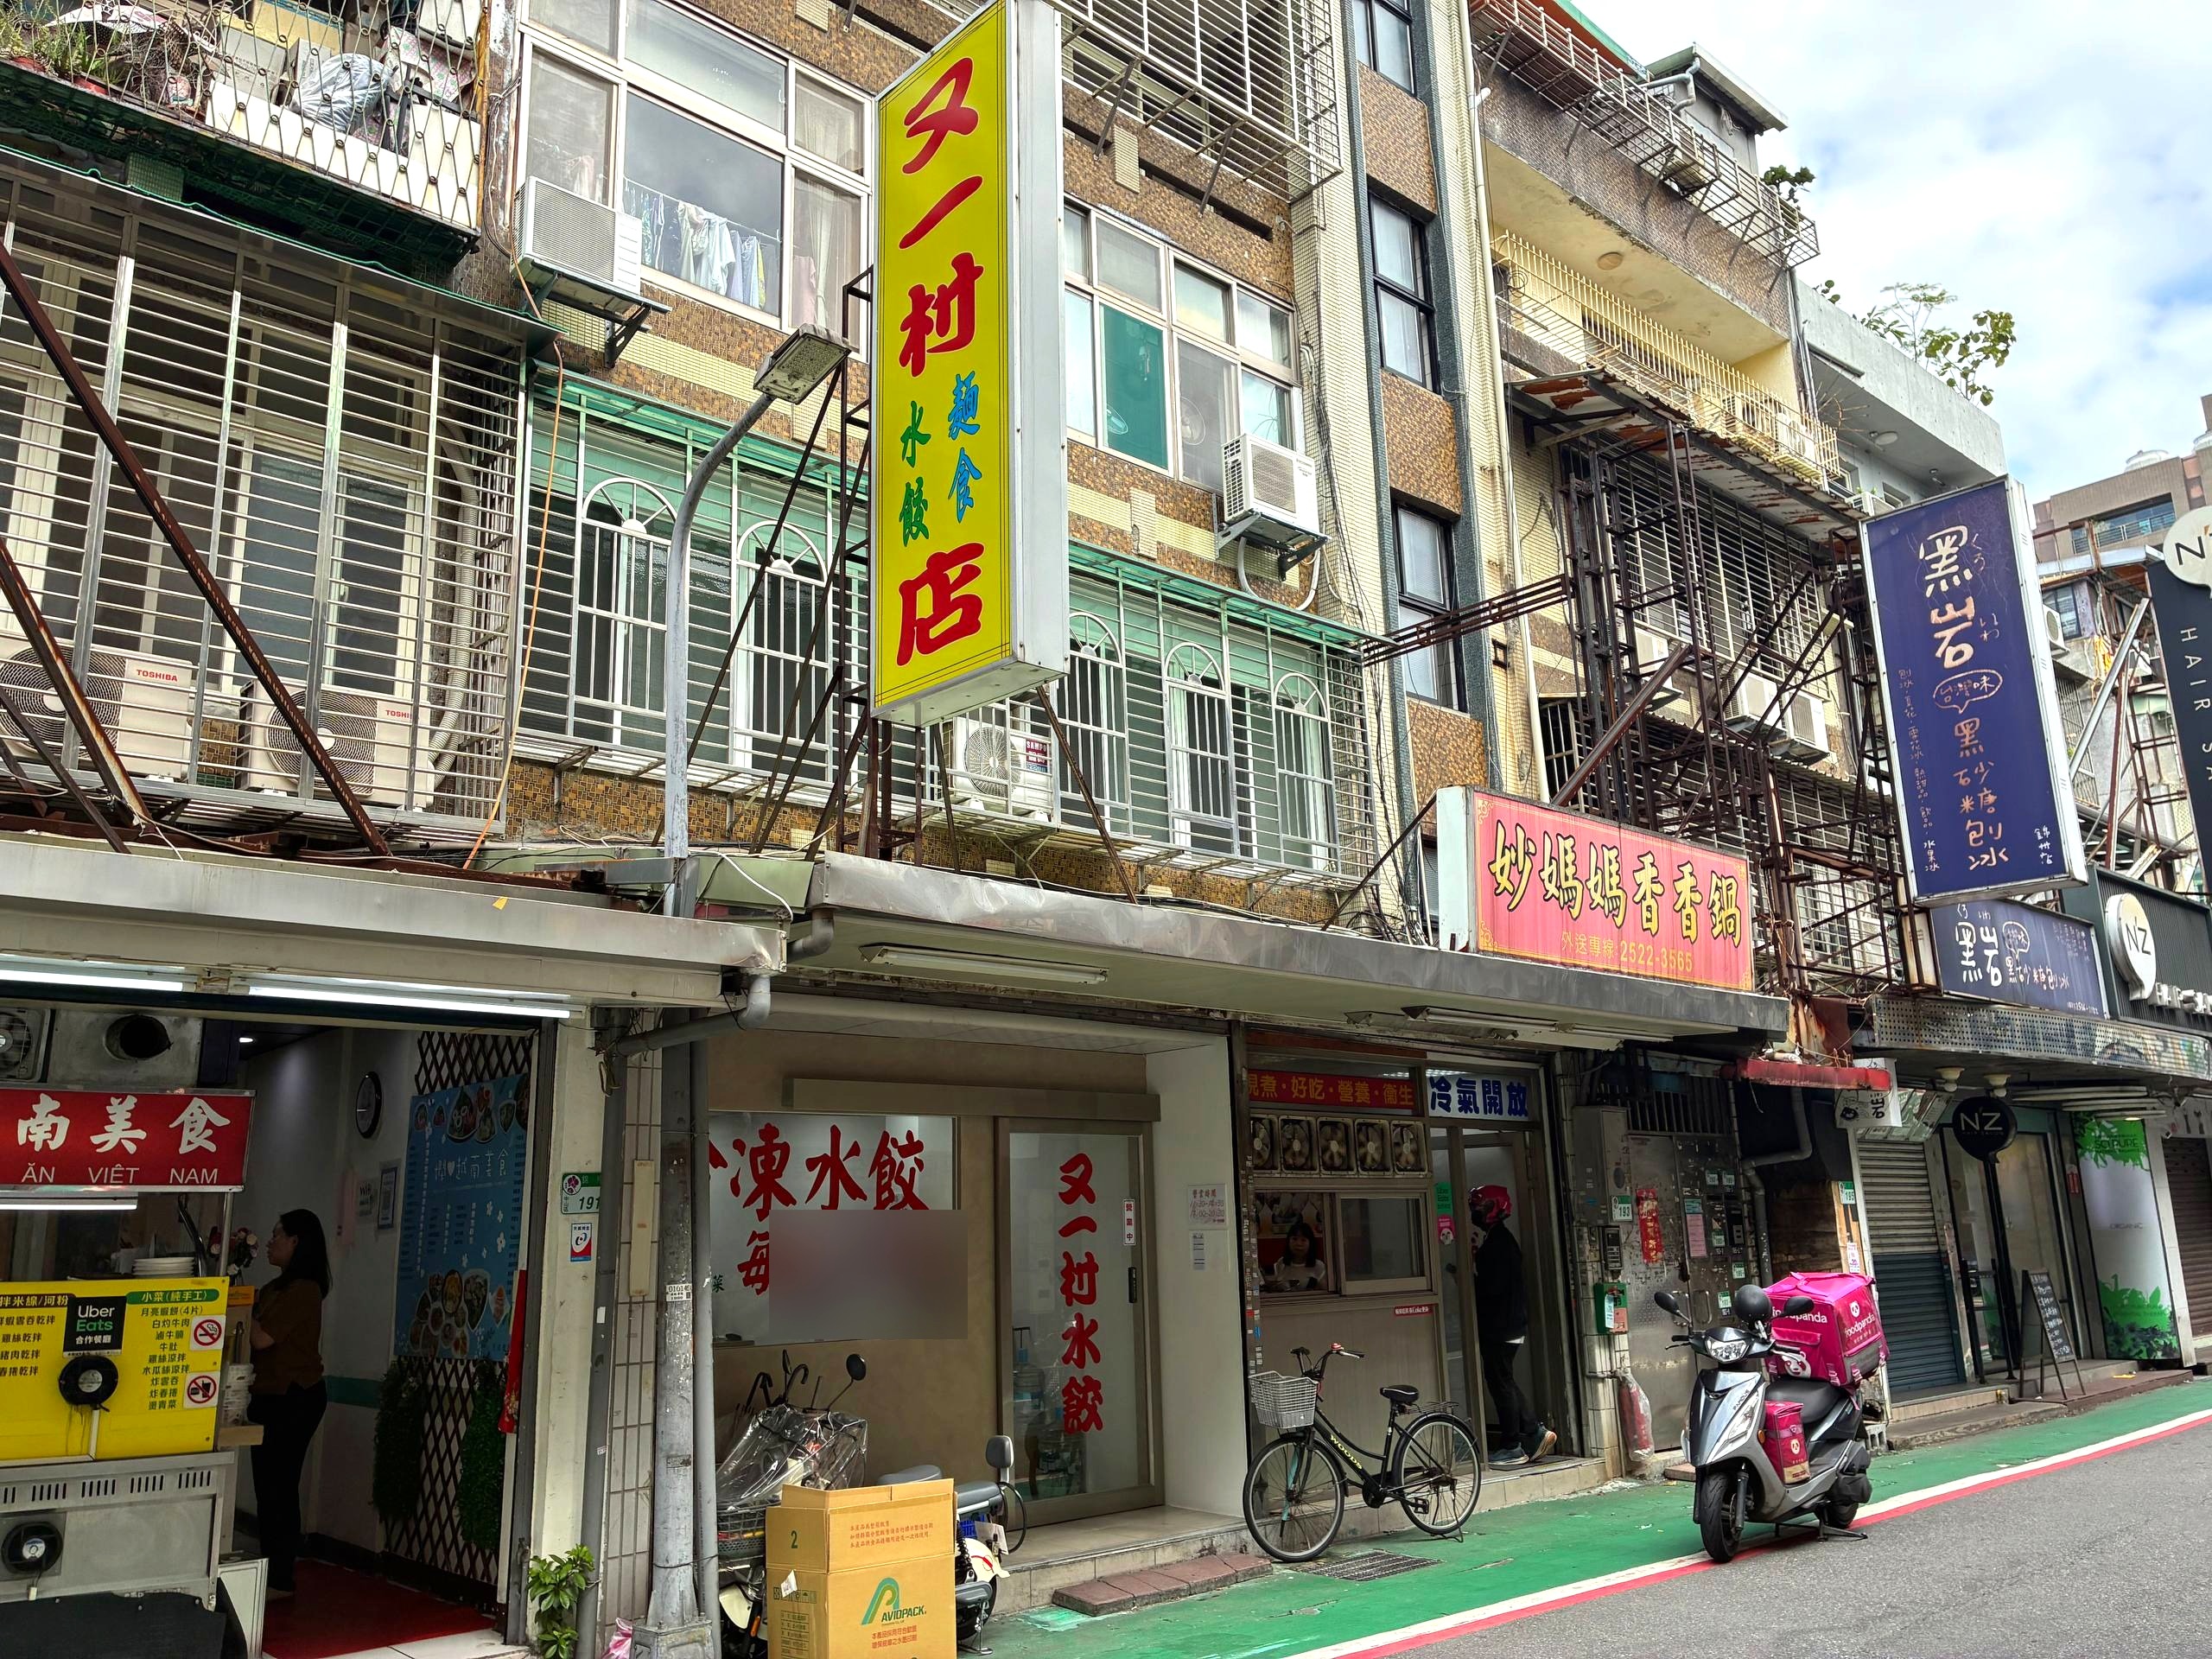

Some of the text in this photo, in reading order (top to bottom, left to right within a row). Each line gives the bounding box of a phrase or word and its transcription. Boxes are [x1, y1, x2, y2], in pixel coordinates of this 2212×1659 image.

[899, 57, 984, 378] 又一村
[899, 399, 931, 549] 水餃
[897, 543, 985, 666] 店
[136, 669, 178, 683] TOSHIBA
[385, 709, 414, 721] TOSHI
[1488, 818, 1742, 948] 妙媽媽香香鍋
[1620, 940, 1693, 972] 2522-3565
[1429, 1077, 1529, 1117] 冷氣開放
[16, 1092, 232, 1155] 南美食
[169, 1168, 218, 1184] NAM
[1058, 1153, 1104, 1434] 又一村水餃
[76, 1319, 113, 1332] Eats
[78, 1305, 115, 1319] Uber
[1845, 1313, 1876, 1338] foodpanda
[790, 1530, 798, 1550] 2
